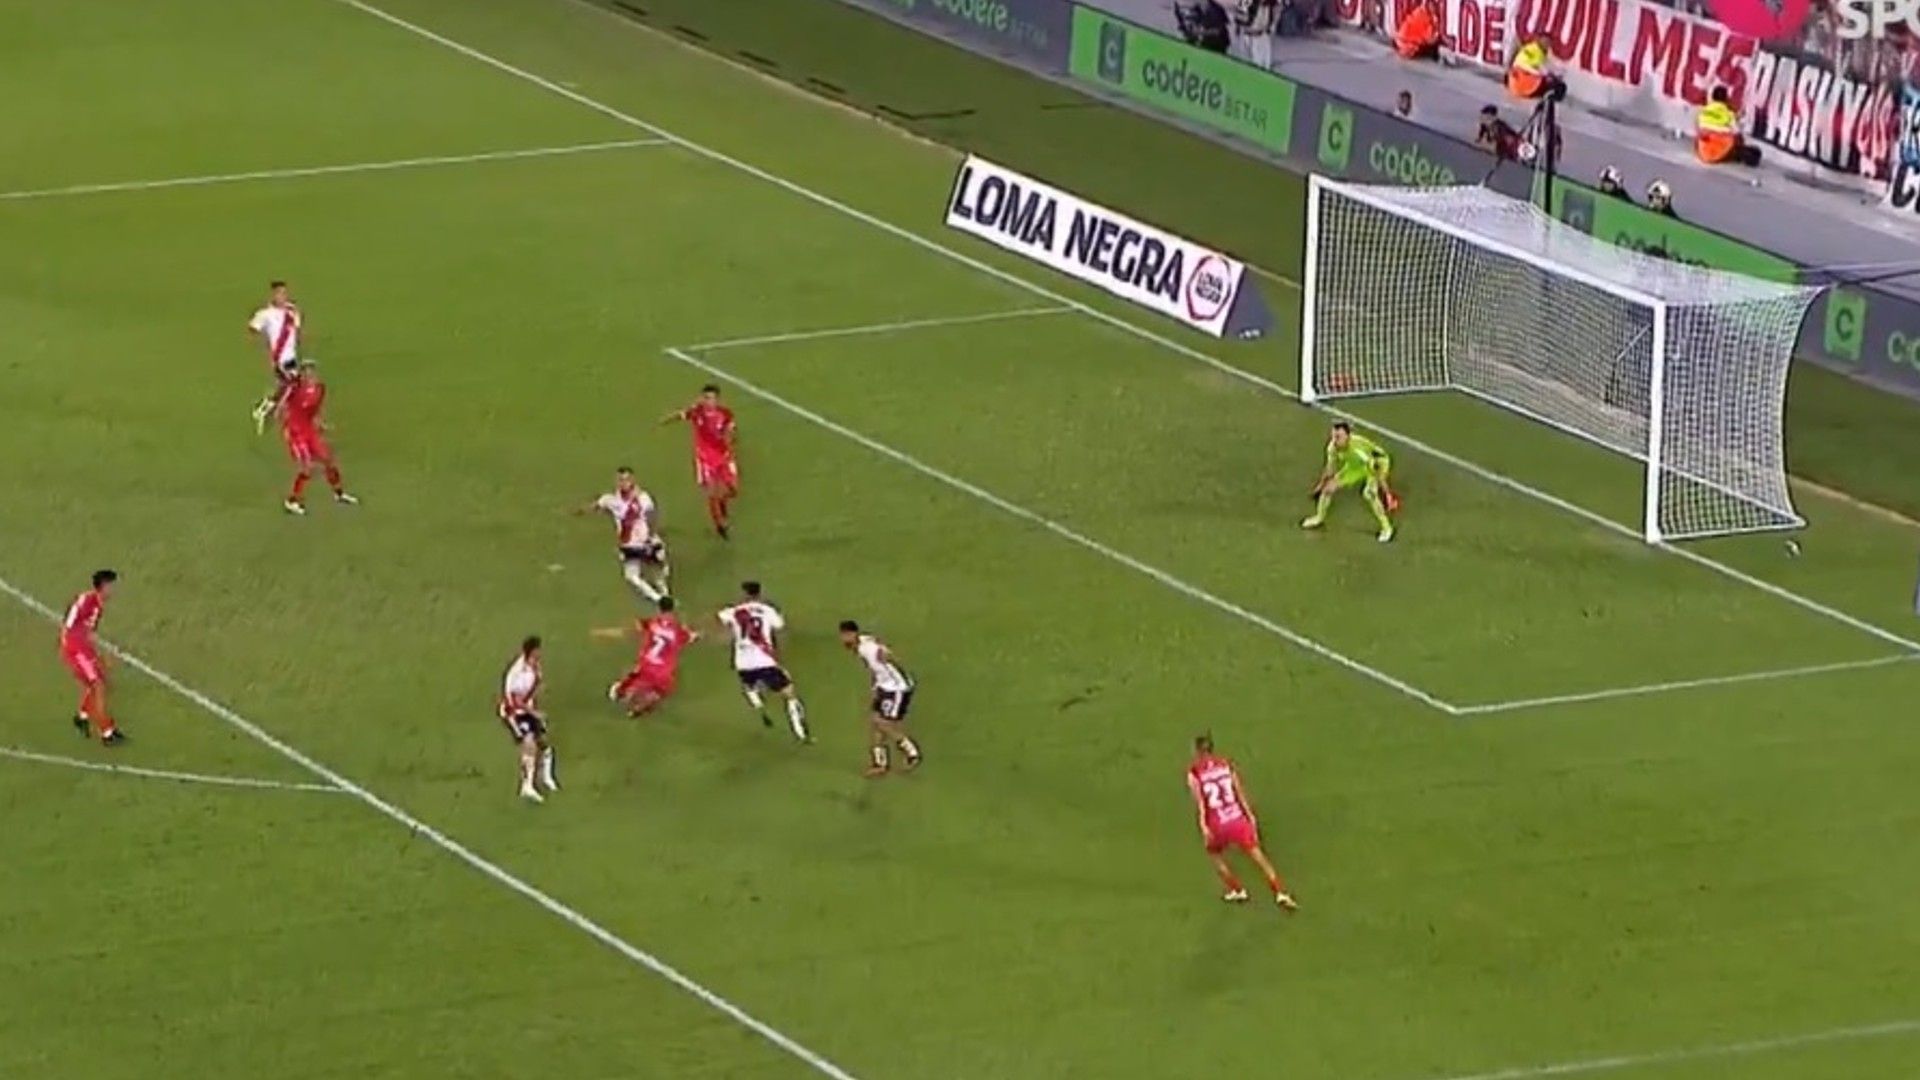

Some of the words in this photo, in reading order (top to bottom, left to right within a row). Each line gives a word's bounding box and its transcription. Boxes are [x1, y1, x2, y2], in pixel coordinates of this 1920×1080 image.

[1142, 57, 1223, 110] codere
[1369, 142, 1456, 186] codere
[952, 166, 1058, 252] LOMA
[1063, 208, 1185, 303] NEGRA
